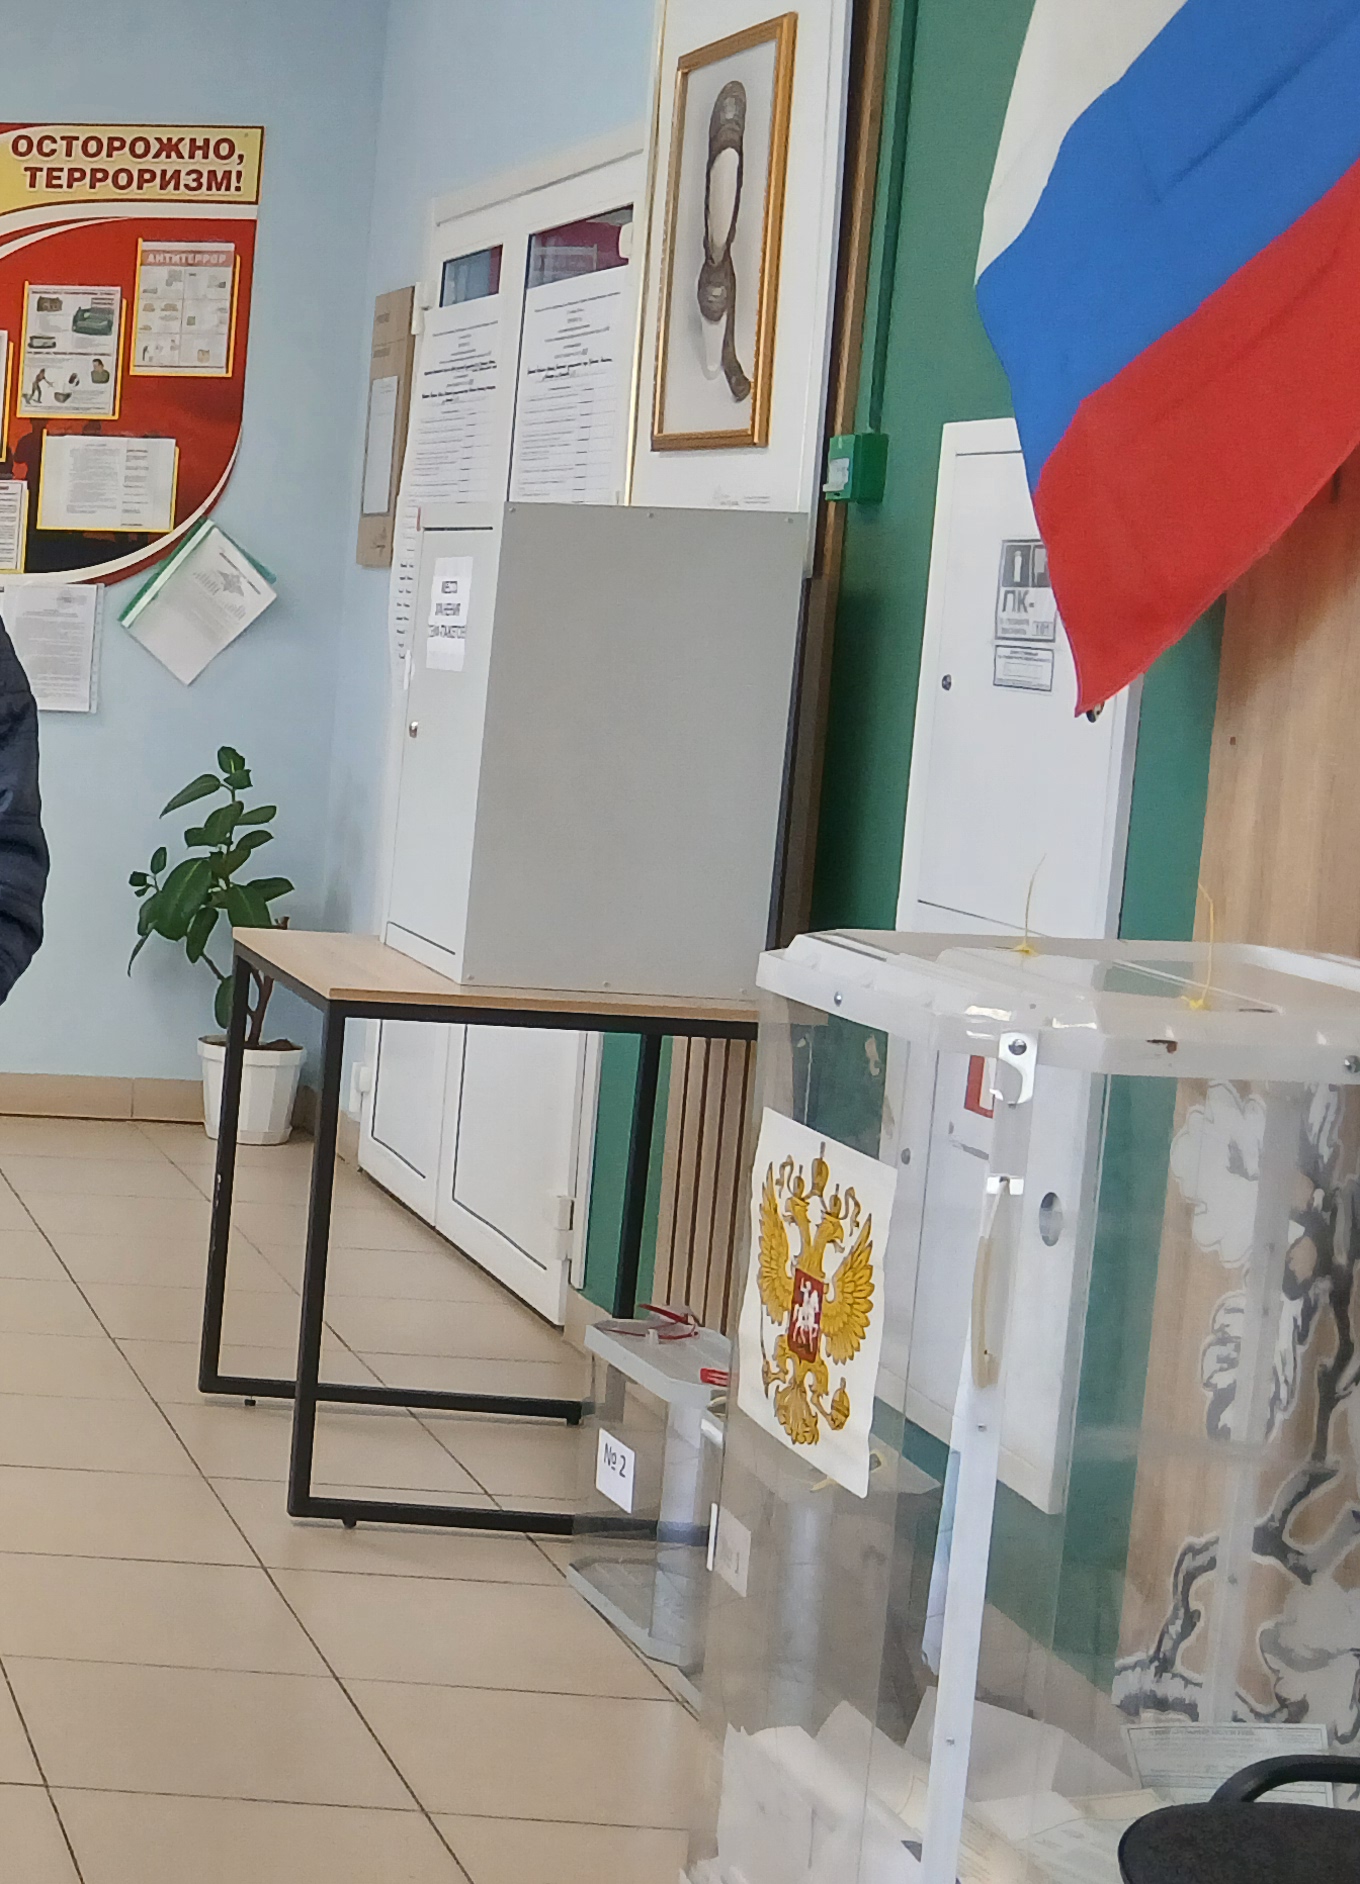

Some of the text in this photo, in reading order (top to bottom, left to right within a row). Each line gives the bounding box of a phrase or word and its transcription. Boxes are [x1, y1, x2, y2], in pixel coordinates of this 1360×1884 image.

[11, 134, 245, 165] ОСТОРОЖНО,
[24, 166, 243, 192] ТЕРРОРИЗМ!
[618, 1454, 627, 1478] 2
